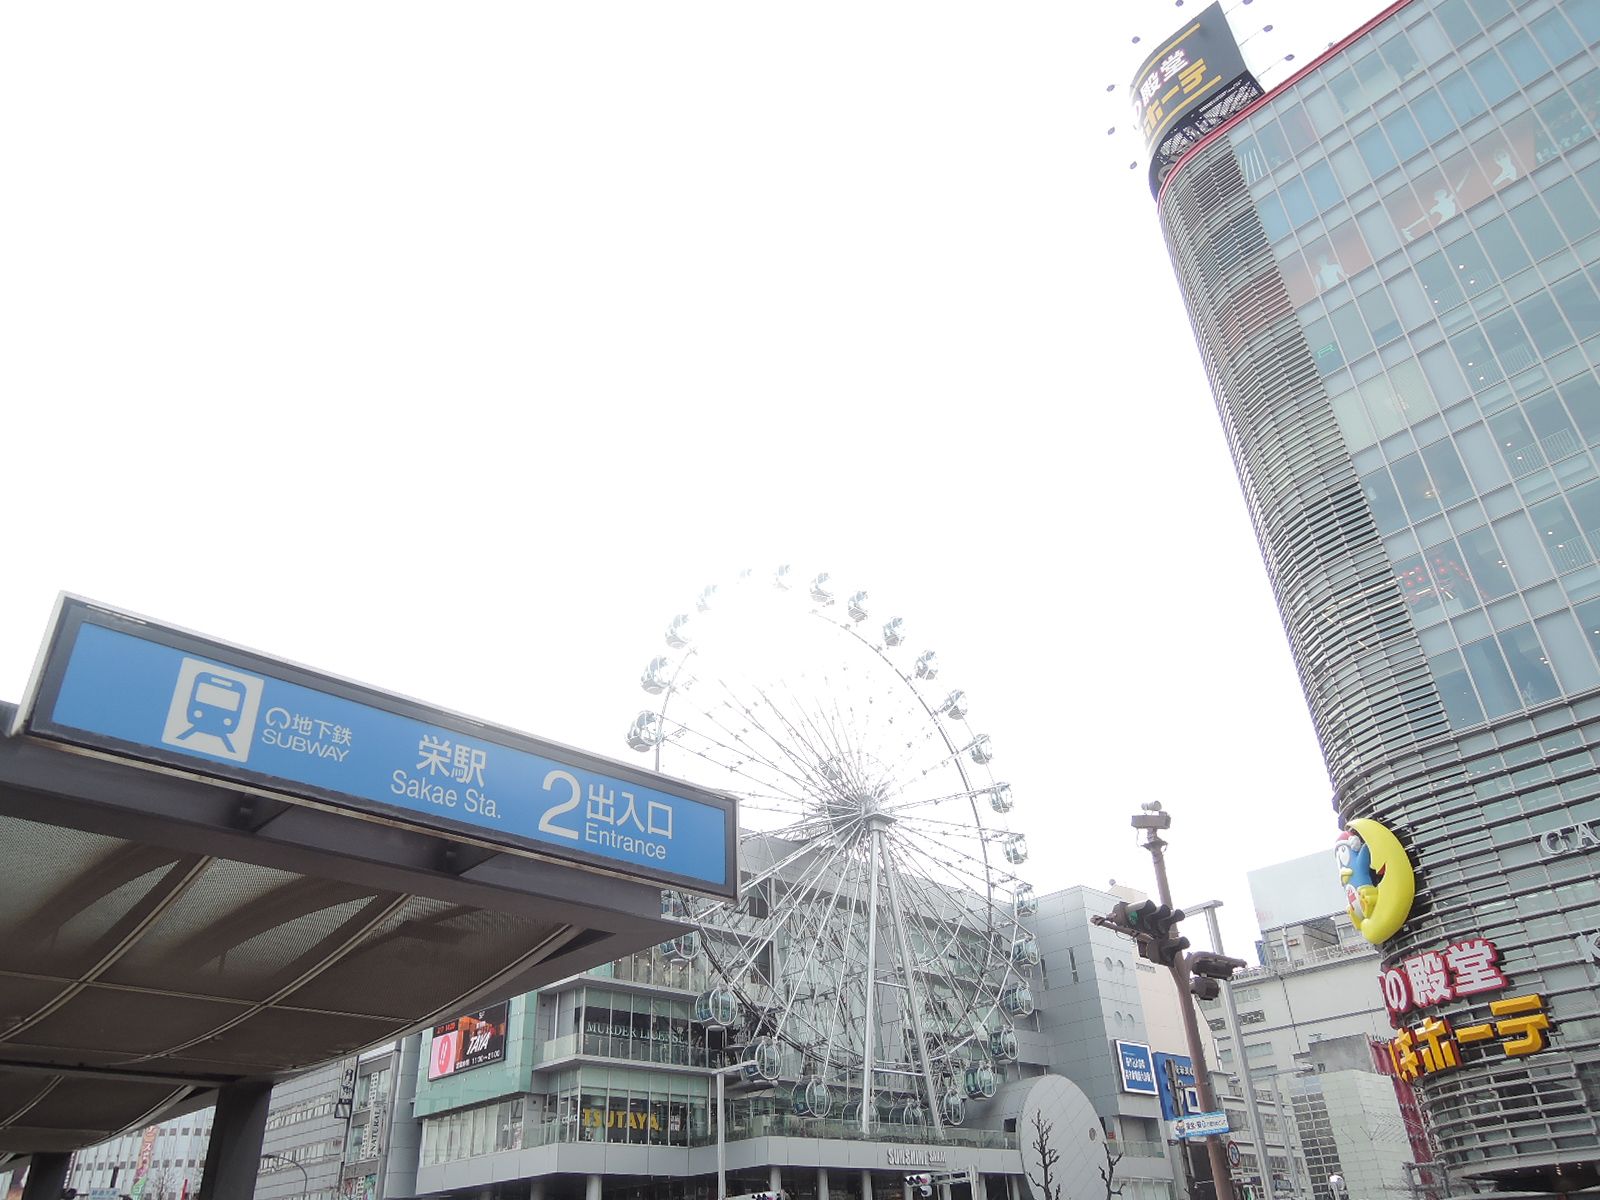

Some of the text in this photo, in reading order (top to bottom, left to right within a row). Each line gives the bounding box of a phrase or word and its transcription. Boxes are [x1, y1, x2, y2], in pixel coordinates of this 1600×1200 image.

[261, 729, 349, 762] SUBWAY
[292, 713, 352, 744] 地下鉄
[417, 734, 487, 788] 栄駅
[390, 770, 501, 818] Sakae Sta.
[538, 770, 579, 838] 2
[587, 784, 673, 838] 出入口
[585, 824, 667, 859] Entrance
[587, 1022, 637, 1038] MURDER
[582, 1108, 660, 1132] TSUTAYA
